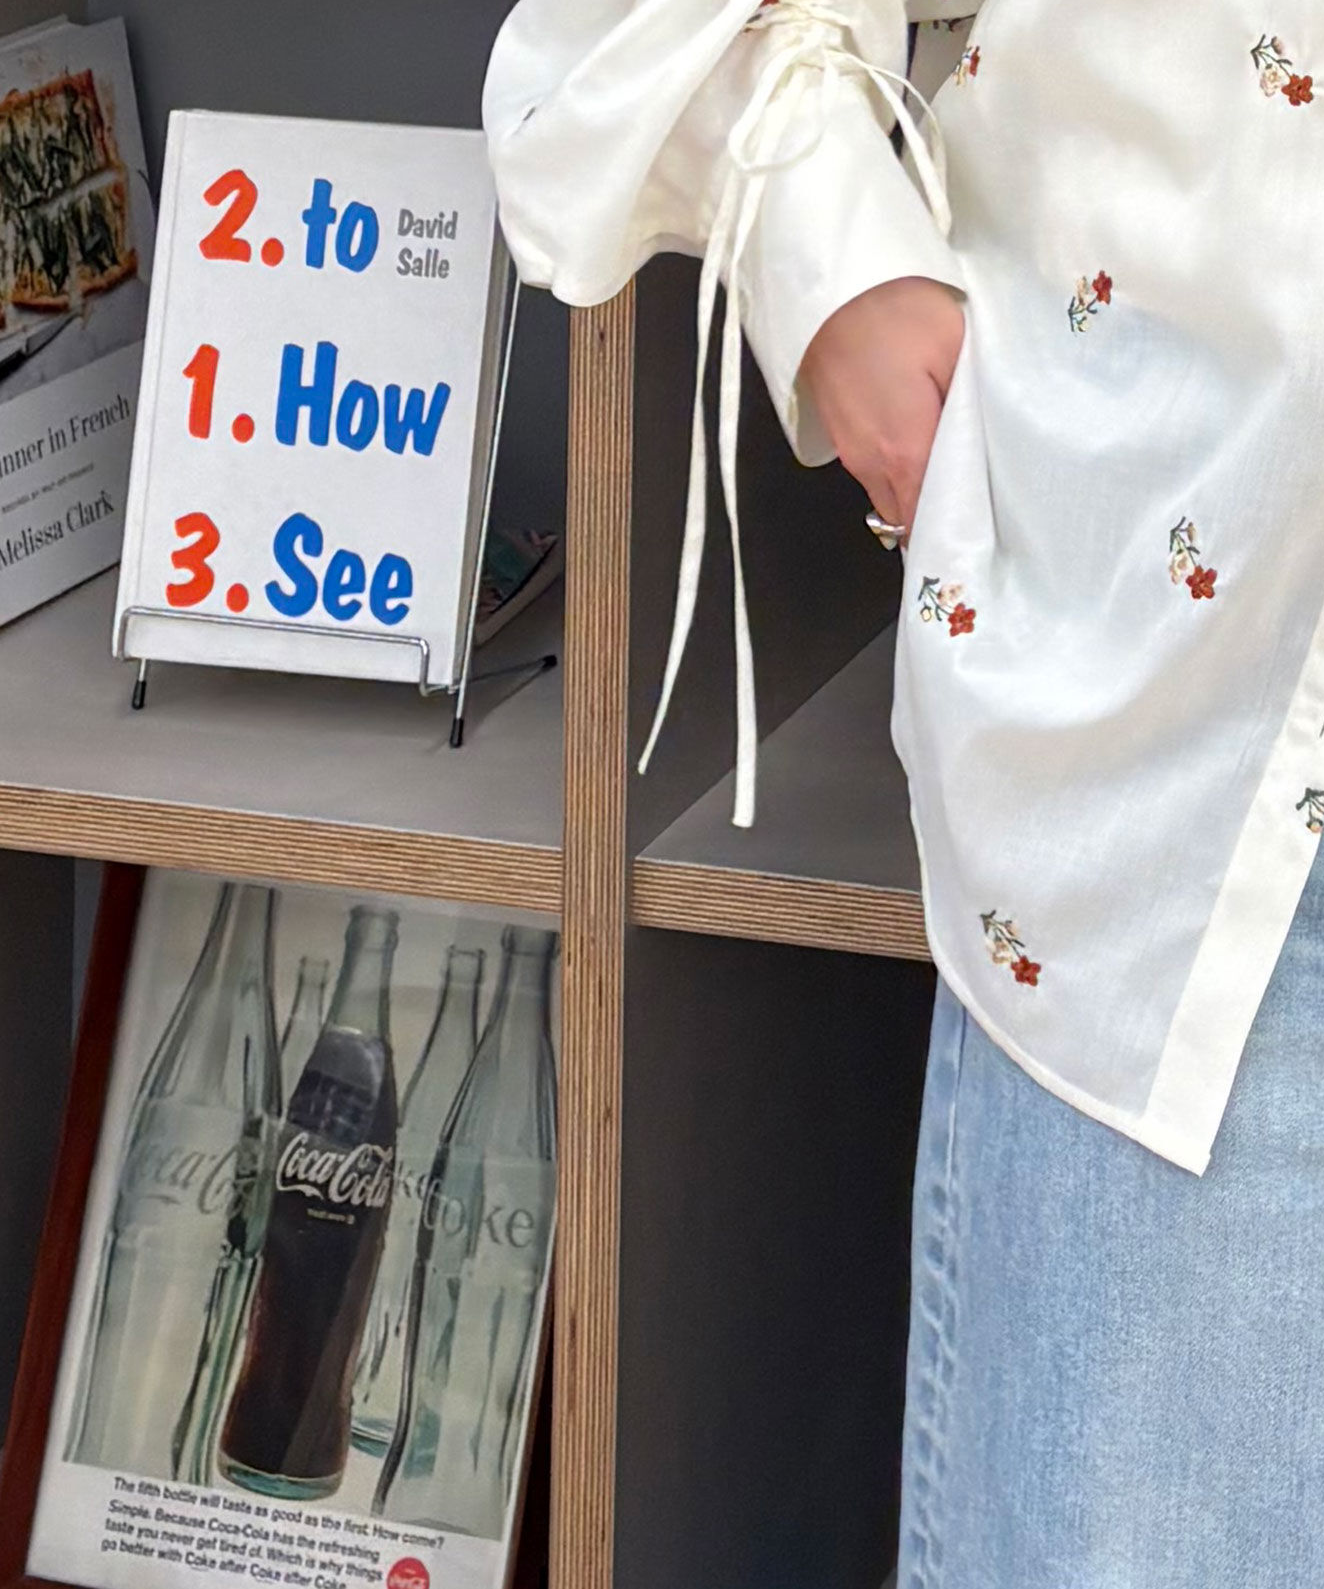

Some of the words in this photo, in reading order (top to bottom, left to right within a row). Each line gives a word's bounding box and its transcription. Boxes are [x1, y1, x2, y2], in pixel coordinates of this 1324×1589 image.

[200, 169, 284, 267] 2.
[302, 178, 380, 273] to
[397, 209, 459, 240] David
[396, 249, 450, 279] Salle
[48, 425, 68, 455] in
[70, 393, 131, 445] French
[182, 344, 256, 442] 1.
[275, 341, 452, 457] How
[67, 489, 115, 533] Clark
[165, 512, 249, 613] 3.
[265, 512, 414, 626] See
[113, 1476, 136, 1492] The
[163, 1486, 198, 1505] bottle
[222, 1497, 252, 1514] taste
[254, 1505, 268, 1517] as
[271, 1507, 303, 1522] good
[304, 1515, 319, 1527] as
[321, 1516, 342, 1532] the
[373, 1525, 400, 1541] How
[402, 1533, 446, 1550] come?
[154, 1507, 206, 1530] Because
[273, 1529, 295, 1546] has
[296, 1534, 317, 1551] the
[318, 1539, 380, 1564] refreshing
[100, 1539, 117, 1552] go
[119, 1540, 155, 1558] better
[157, 1548, 183, 1563] with
[184, 1552, 217, 1569] Coke
[218, 1558, 247, 1574] after
[250, 1563, 282, 1582] Coke
[284, 1570, 312, 1586] after
[105, 1518, 135, 1535] taste
[137, 1526, 159, 1539] you
[160, 1530, 195, 1545] never
[196, 1536, 219, 1551] get
[219, 1539, 248, 1556] tired
[266, 1547, 302, 1565] Which
[305, 1556, 316, 1569] is
[318, 1559, 343, 1575] why
[345, 1563, 384, 1582] things
